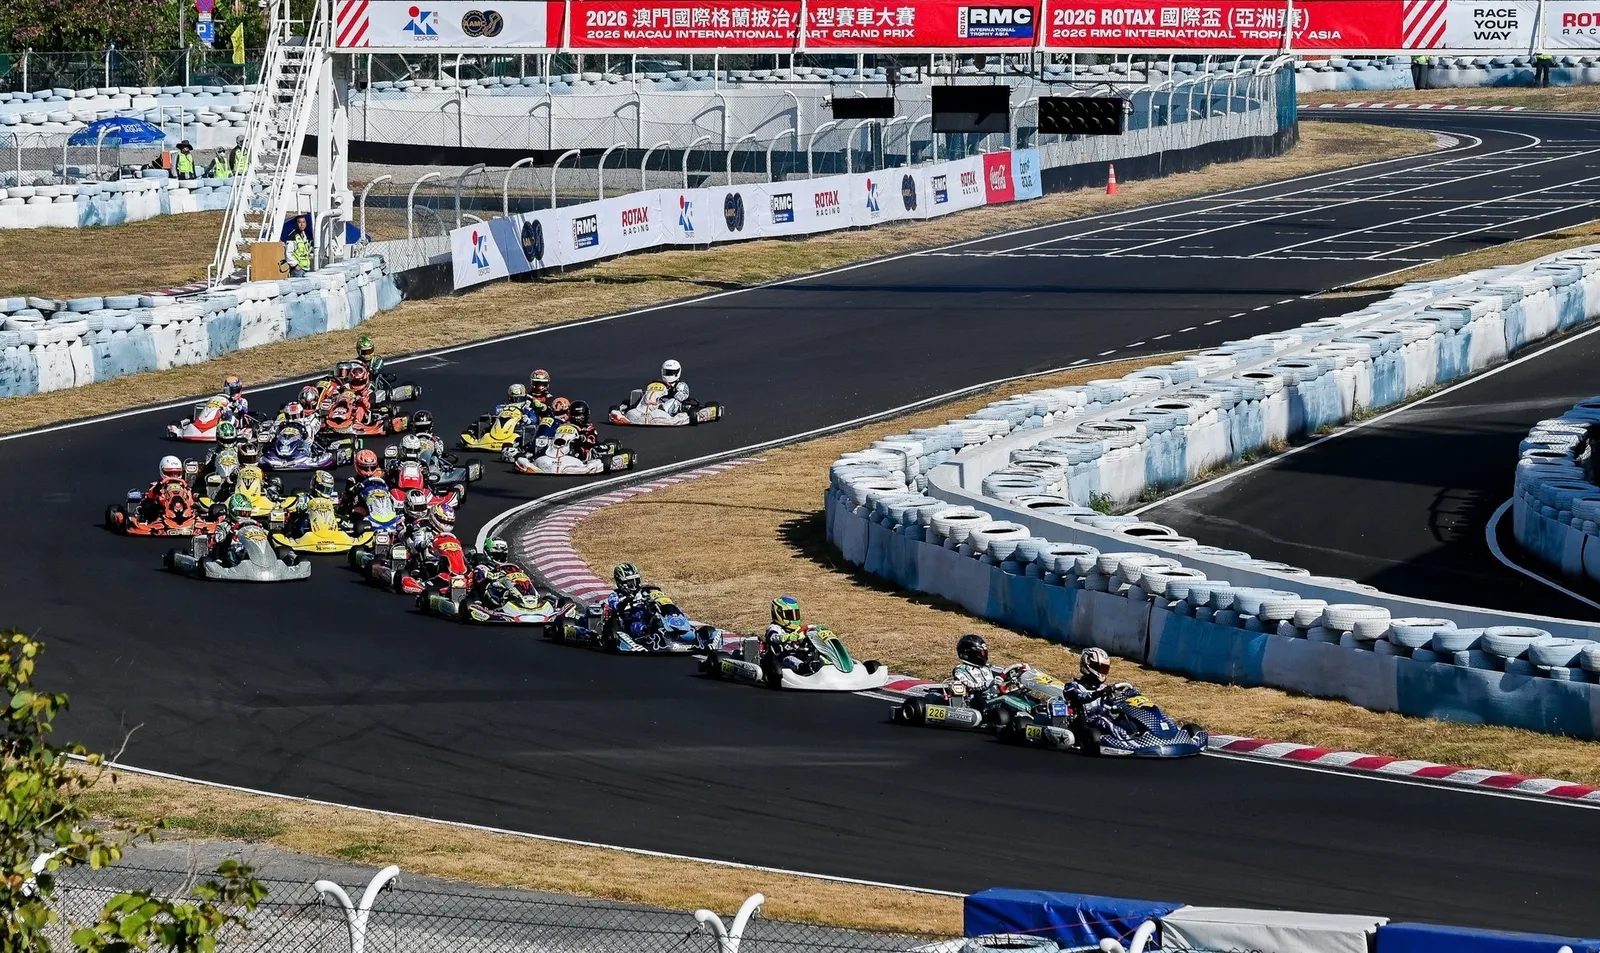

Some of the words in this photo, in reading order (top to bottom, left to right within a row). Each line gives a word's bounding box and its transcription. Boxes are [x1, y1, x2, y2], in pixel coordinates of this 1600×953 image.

[586, 10, 627, 27] 2026
[970, 8, 1031, 24] RMC
[1053, 8, 1096, 26] 2026
[1101, 8, 1156, 26] ROTAX
[1160, 7, 1222, 28] 國際盃
[1473, 9, 1517, 18] RACE
[1474, 20, 1518, 29] YOUR
[587, 30, 621, 39] 2026
[623, 30, 672, 39] MACAU
[675, 29, 783, 39] INTERNATIONAL
[786, 29, 829, 39] KART
[832, 29, 880, 38] GRAND
[883, 29, 915, 38] PRIX
[1052, 29, 1087, 38] 2026
[1090, 29, 1122, 38] RMC
[1124, 29, 1237, 39] INTERNATIONAL
[1239, 30, 1304, 40] TROPHY
[1307, 31, 1342, 39] ASIA
[1473, 31, 1512, 41] WAY
[774, 195, 792, 210] RMC
[815, 189, 840, 208] ROTAX
[621, 206, 648, 227] ROTAX
[816, 206, 841, 216] RACING
[576, 217, 597, 235] RMC
[623, 224, 649, 236] RACING
[929, 708, 945, 718] 226
[1027, 726, 1041, 737] 212
